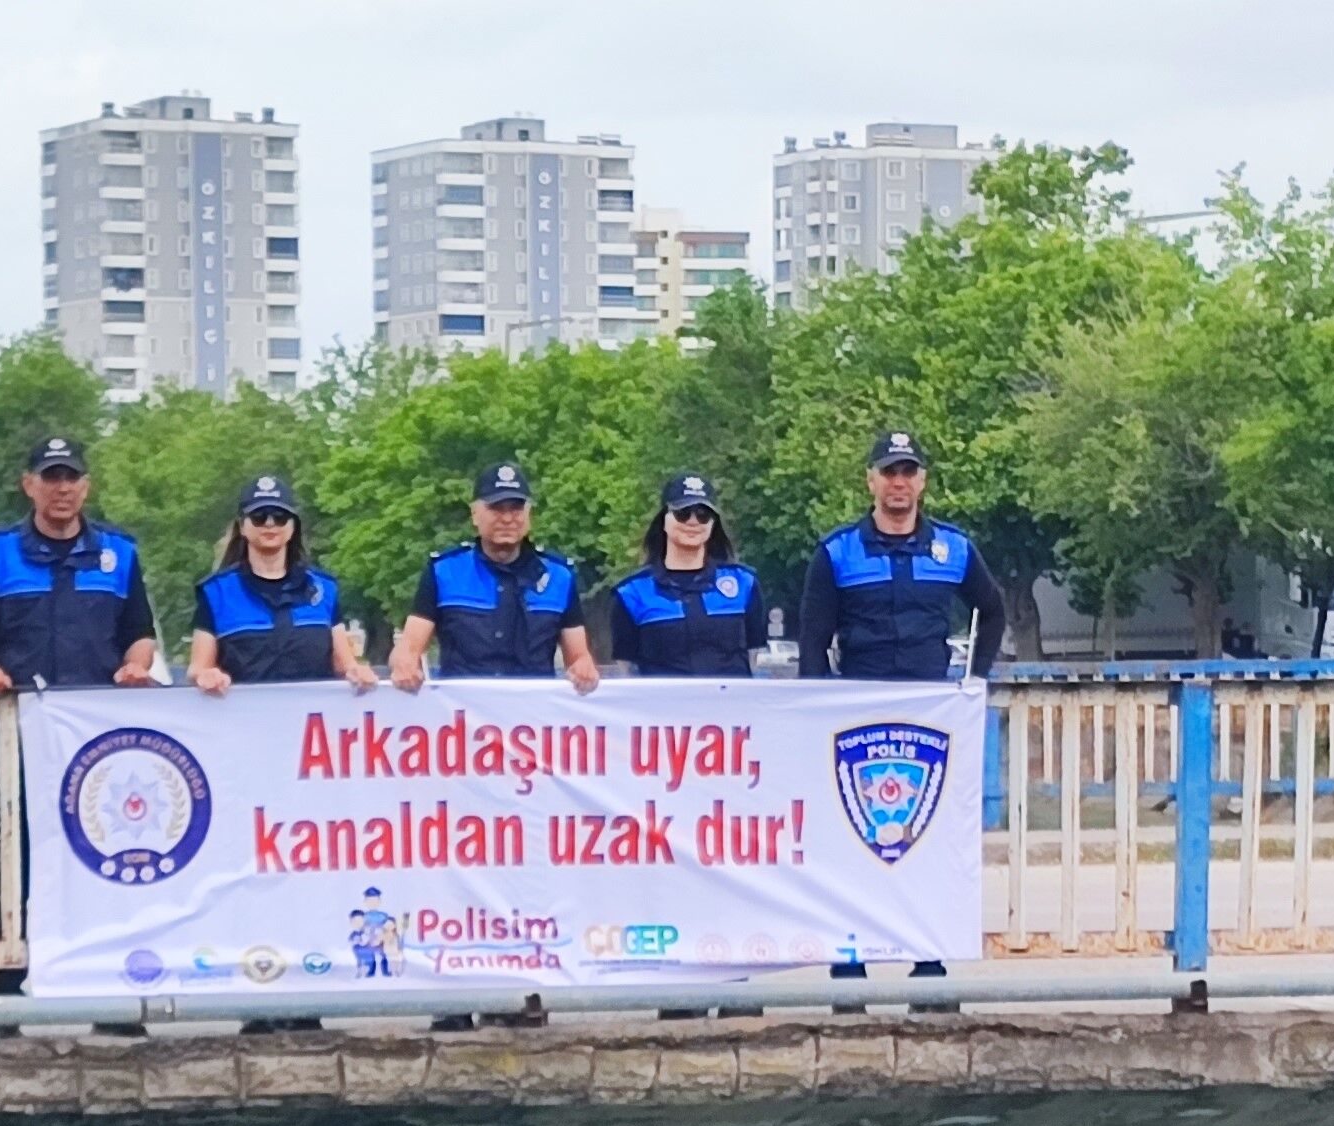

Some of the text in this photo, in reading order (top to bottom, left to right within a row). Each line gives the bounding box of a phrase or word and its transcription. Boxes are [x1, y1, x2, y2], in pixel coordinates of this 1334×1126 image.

[297, 709, 761, 796] Arkadaşını uyar,
[837, 730, 887, 751] TOPLUM
[867, 741, 916, 760] POLİS
[253, 799, 804, 874] kanaldan uzak dur!
[417, 906, 559, 943] Polisim
